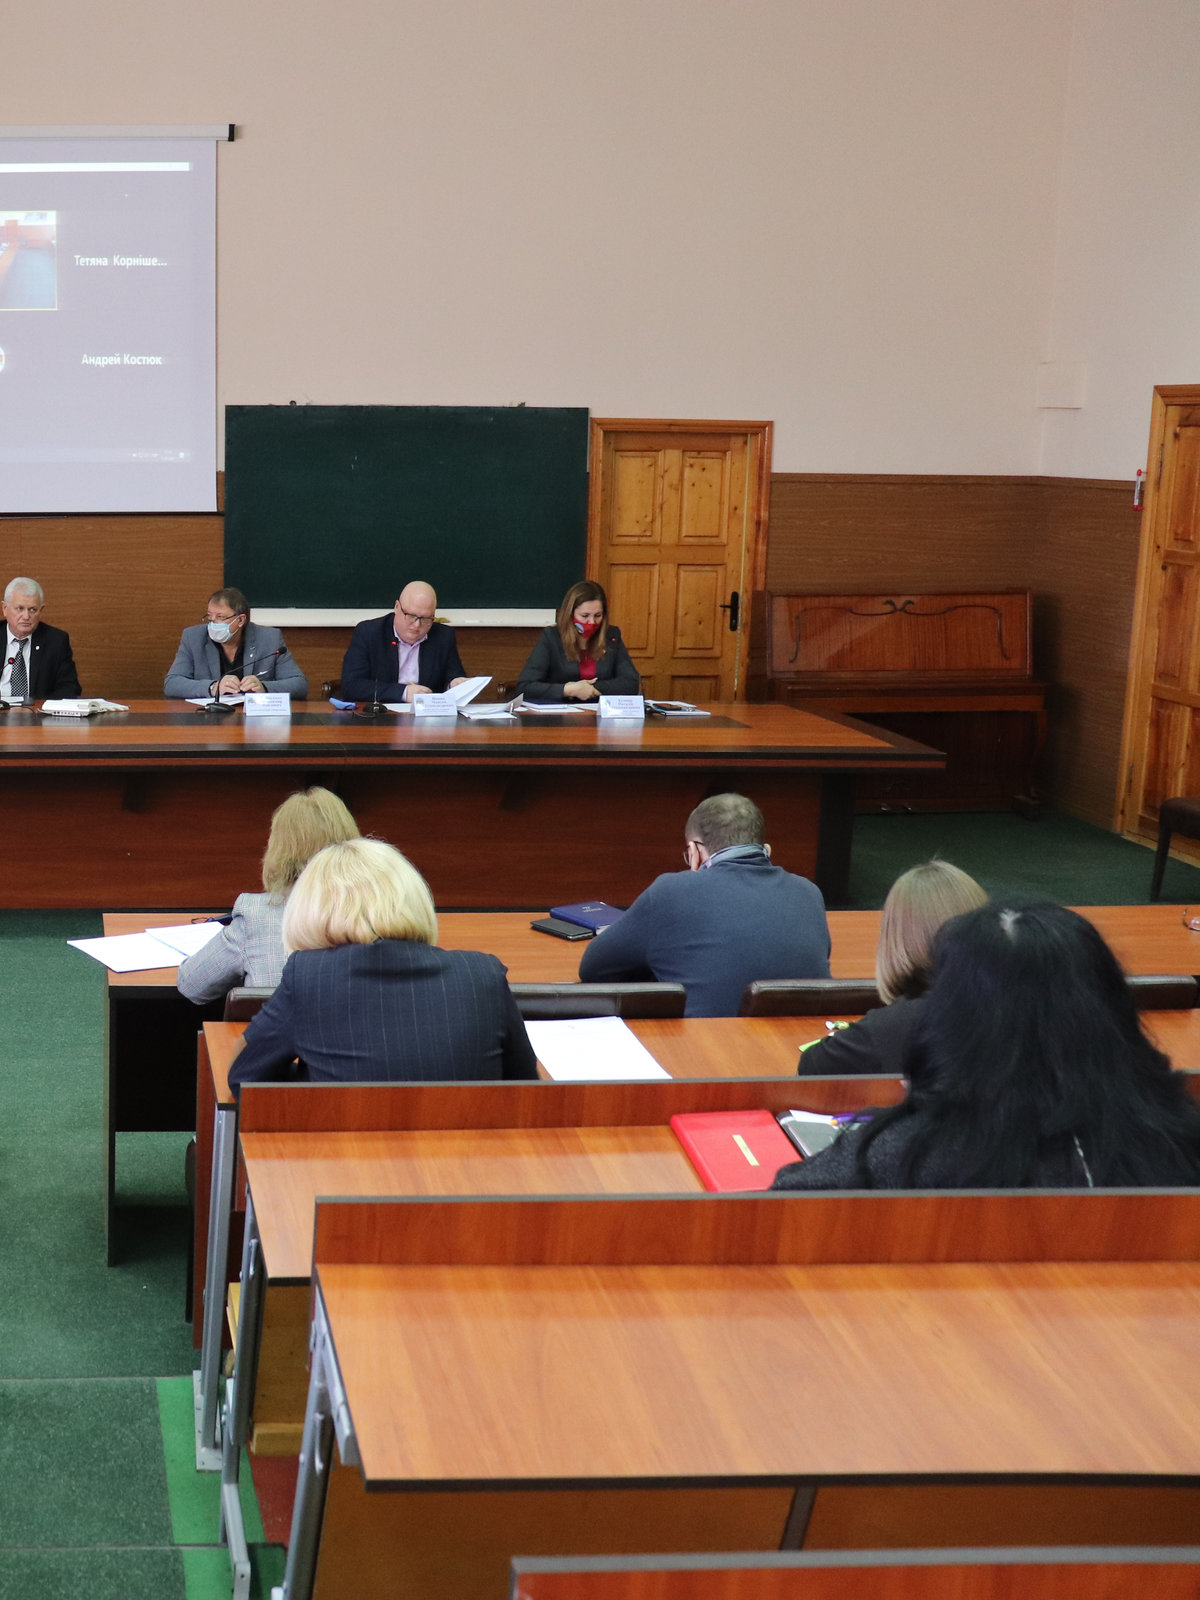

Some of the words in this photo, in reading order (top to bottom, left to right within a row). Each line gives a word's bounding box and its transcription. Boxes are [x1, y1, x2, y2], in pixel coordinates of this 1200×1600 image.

[73, 254, 109, 266] Тетяна
[81, 353, 121, 368] Андрей
[123, 353, 163, 365] Костюк
